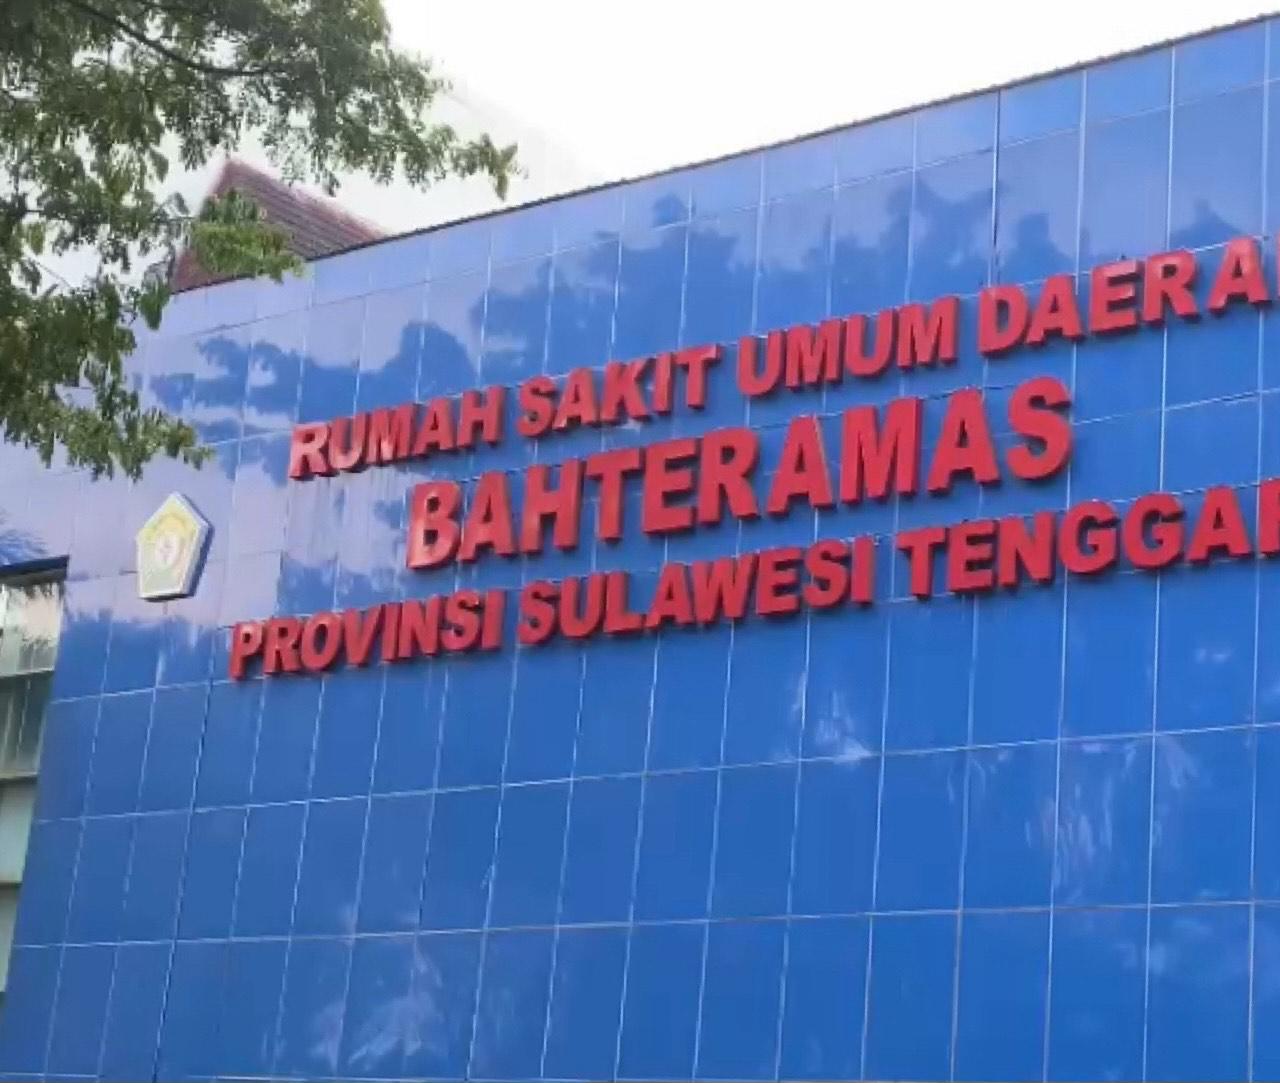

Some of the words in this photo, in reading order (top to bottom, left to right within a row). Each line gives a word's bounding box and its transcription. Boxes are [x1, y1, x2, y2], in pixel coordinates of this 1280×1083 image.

[289, 386, 503, 480] RUMAH
[517, 345, 722, 438] SAKIT
[736, 296, 959, 398] UMUM
[406, 376, 1073, 571] BAHTERAMAS
[228, 587, 506, 680] PROVINSI
[517, 535, 875, 646] SULAWESI
